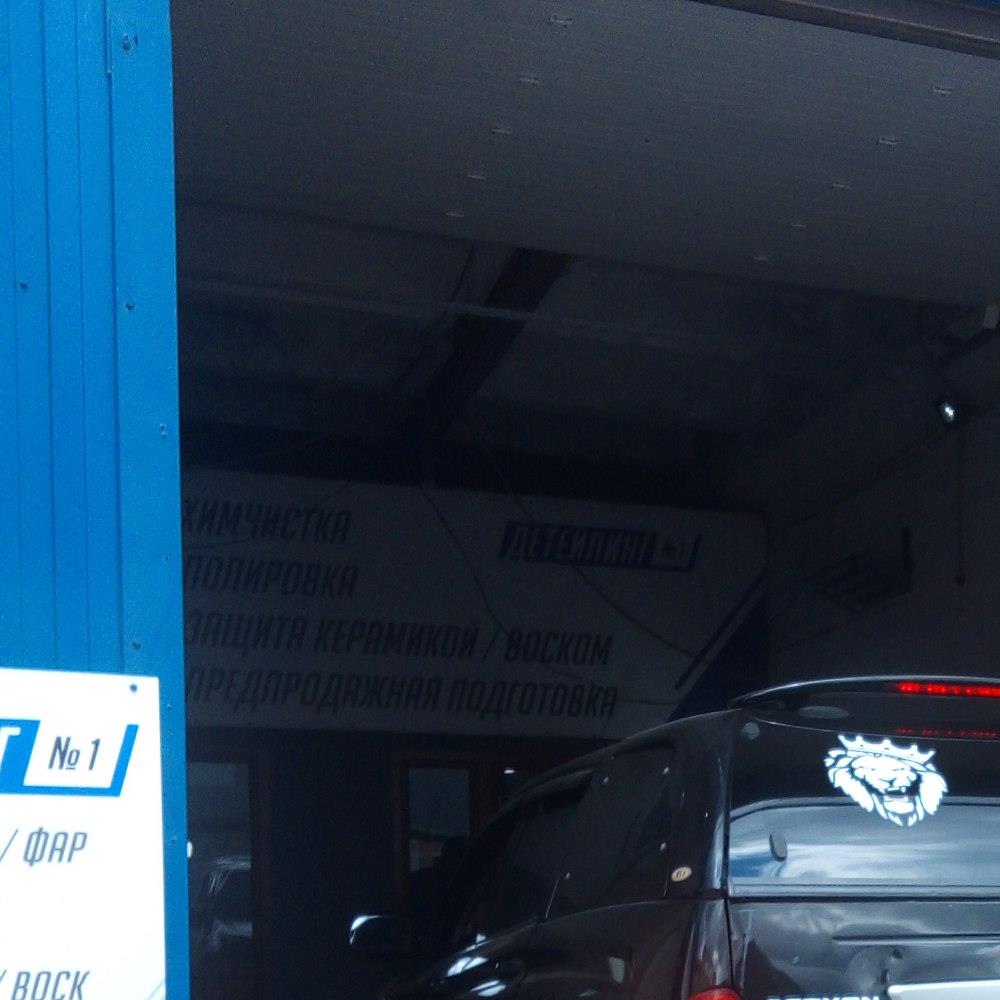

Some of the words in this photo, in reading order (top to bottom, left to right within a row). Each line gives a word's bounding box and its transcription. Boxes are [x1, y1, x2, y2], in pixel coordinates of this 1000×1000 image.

[313, 618, 480, 659] КЕРАМИКОЙ
[505, 629, 615, 665] ВОСКОМ
[448, 677, 619, 720] ПОДГОТОВКА
[23, 827, 88, 867] ФАР
